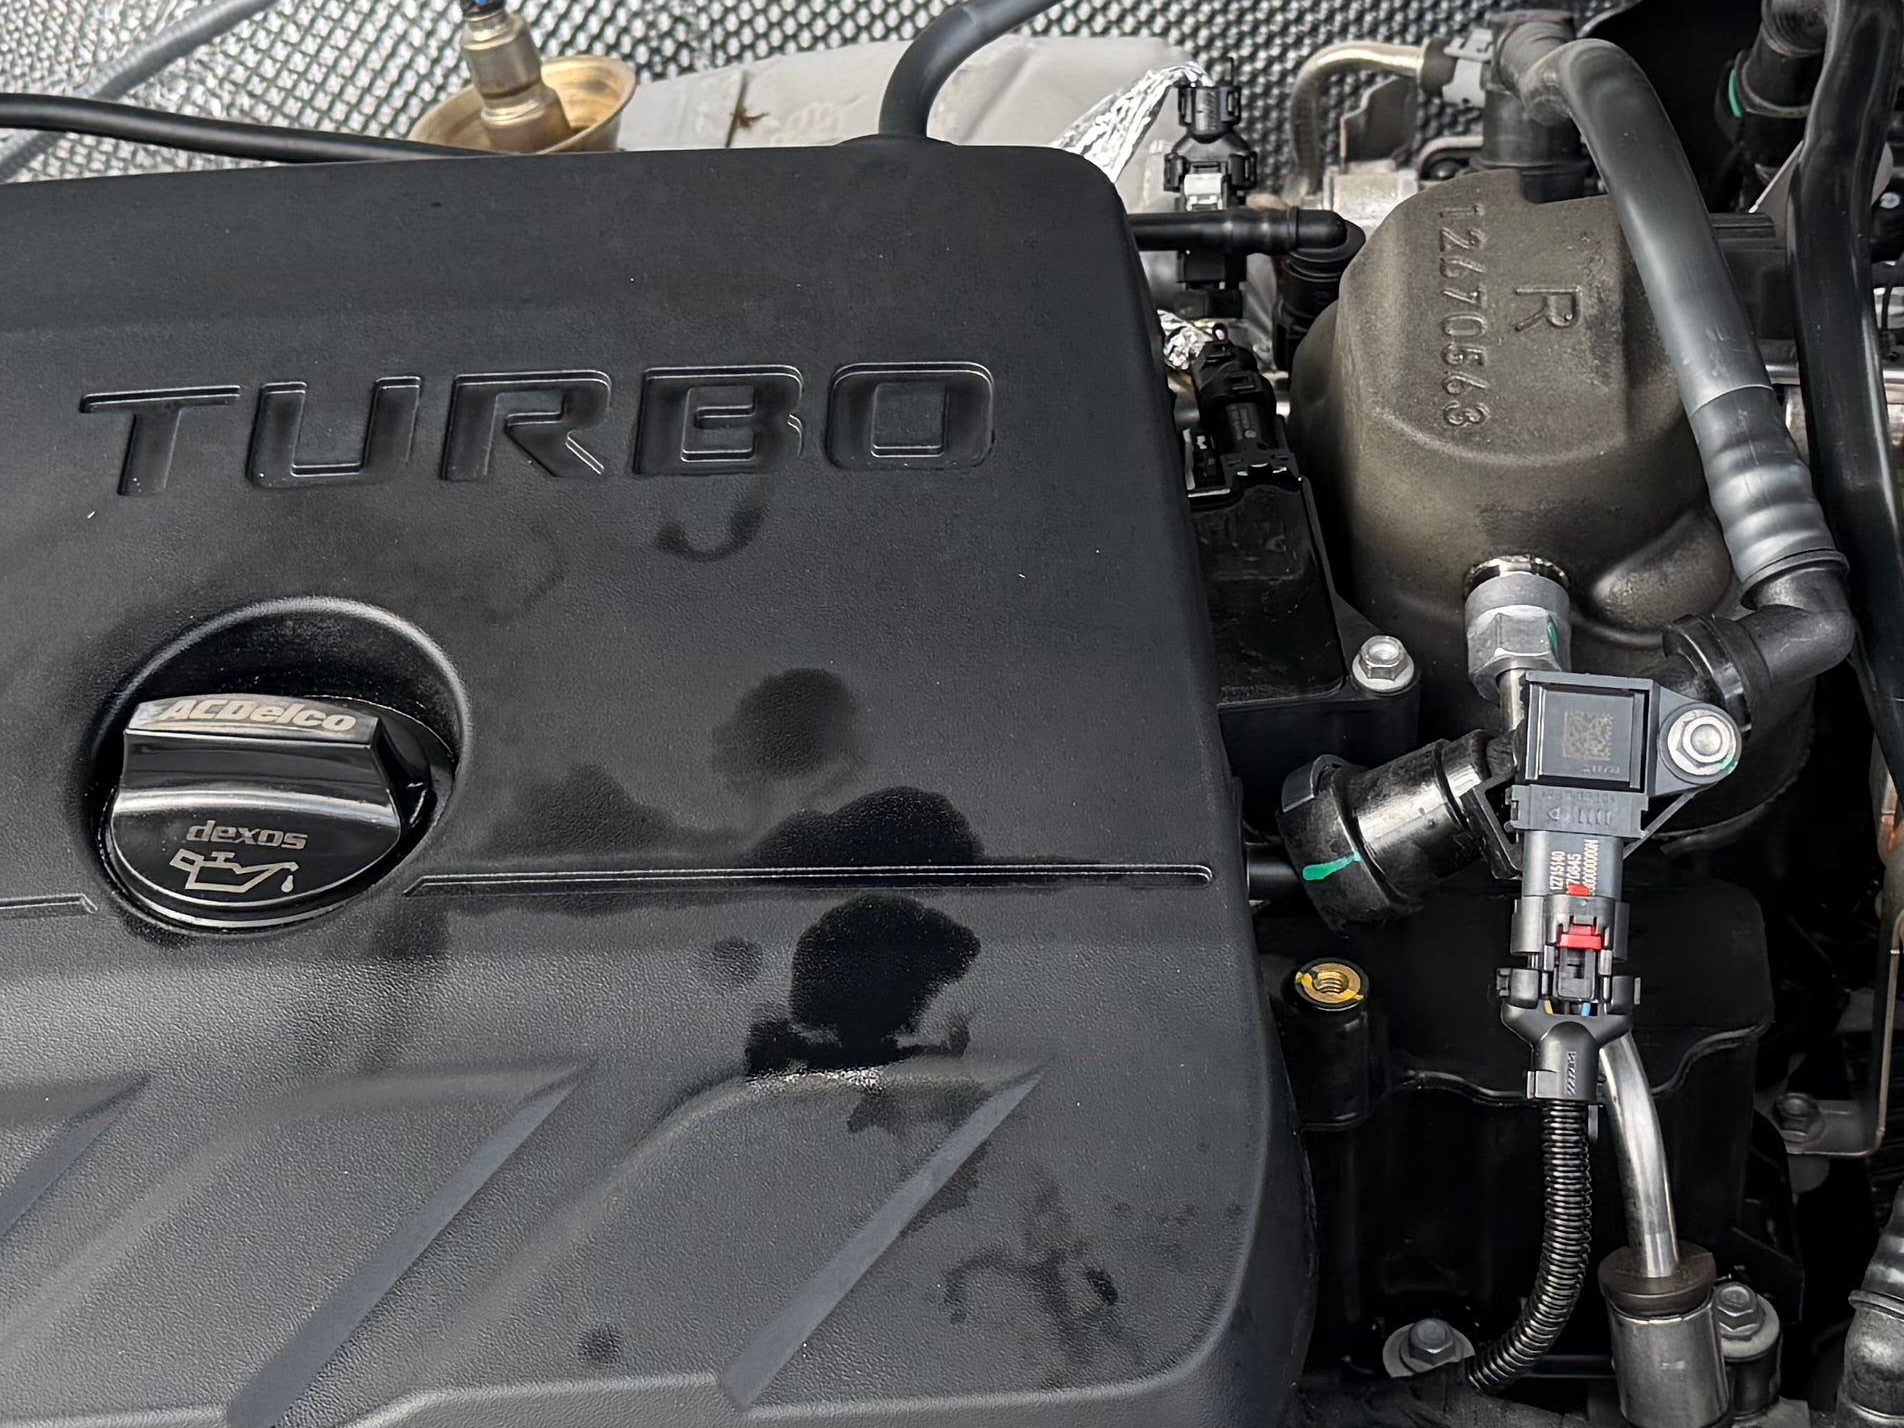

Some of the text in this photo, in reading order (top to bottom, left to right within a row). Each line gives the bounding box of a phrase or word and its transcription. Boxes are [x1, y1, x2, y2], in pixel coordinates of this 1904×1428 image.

[1439, 203, 1491, 428] 12670563
[1513, 283, 1584, 333] R
[78, 359, 996, 497] TURBO
[158, 699, 357, 733] ACDelco
[185, 819, 309, 850] dexos
